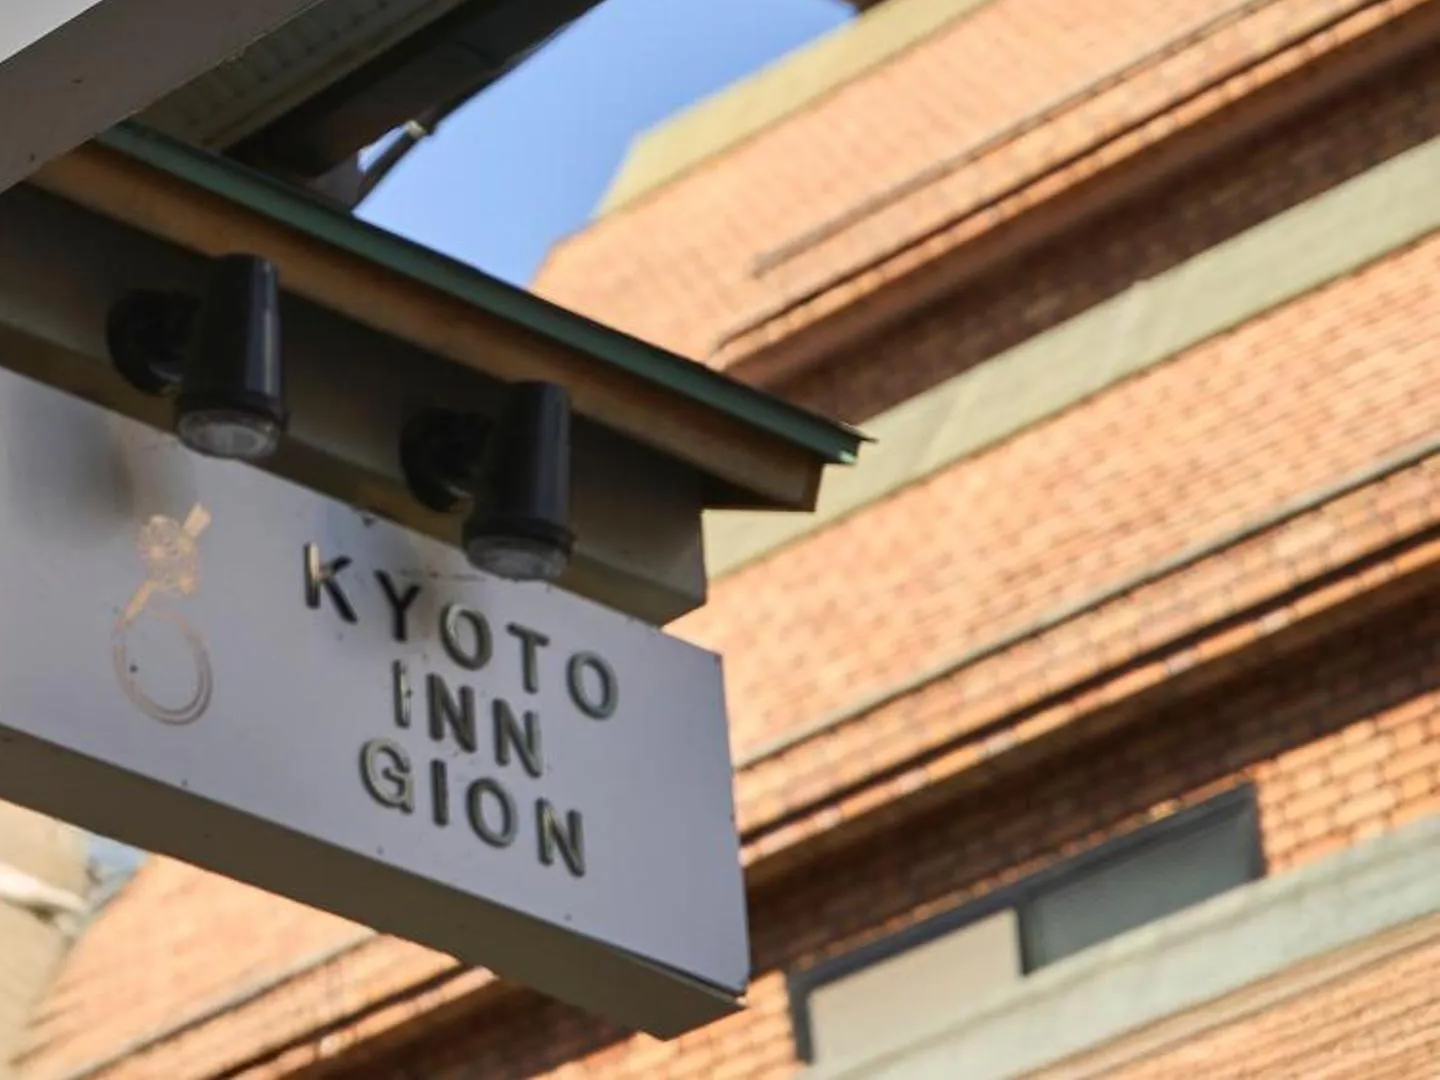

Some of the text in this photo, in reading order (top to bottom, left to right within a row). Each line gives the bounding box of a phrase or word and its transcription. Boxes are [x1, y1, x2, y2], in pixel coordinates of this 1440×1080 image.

[303, 541, 619, 720] KYOTO
[392, 659, 543, 779] INN
[359, 738, 586, 878] GION
